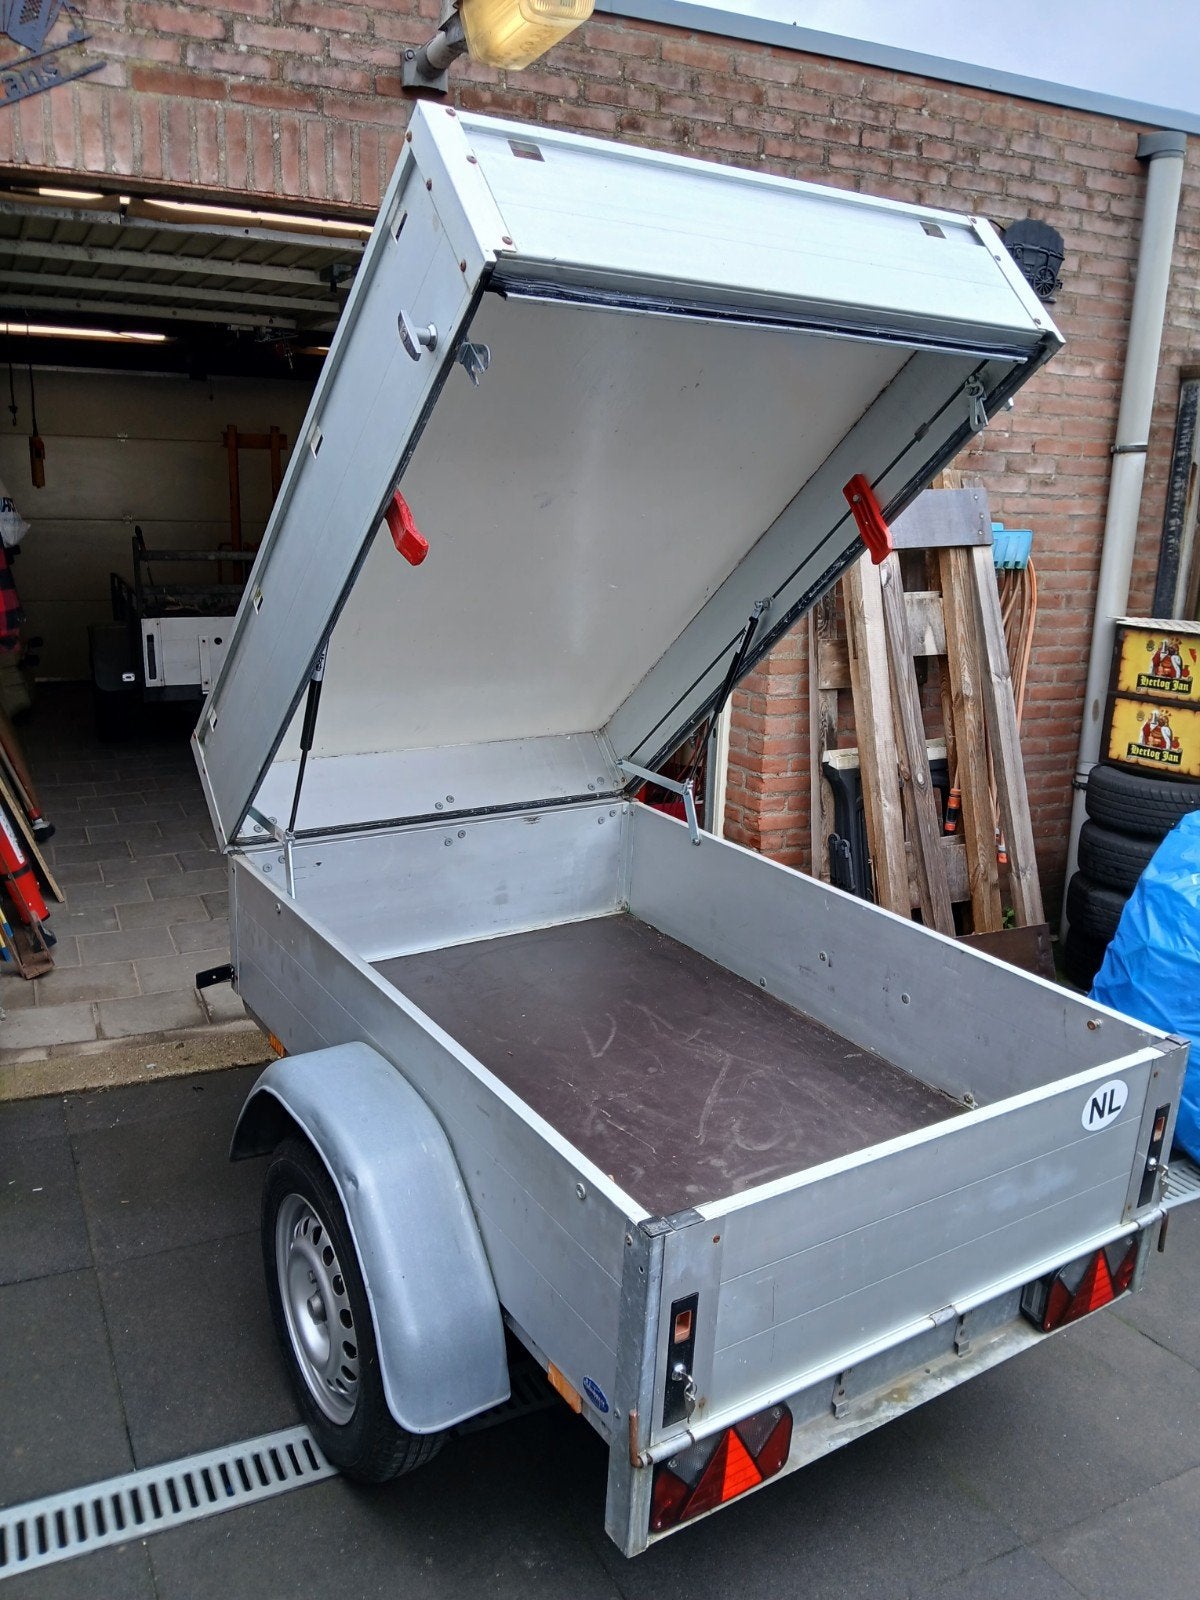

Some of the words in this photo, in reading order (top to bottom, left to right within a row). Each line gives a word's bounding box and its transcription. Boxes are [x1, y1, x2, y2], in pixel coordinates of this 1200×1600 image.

[1141, 675, 1170, 690] Hertog
[1172, 680, 1189, 691] Jan
[1131, 744, 1160, 760] Hertog
[1161, 751, 1179, 762] Jan
[1089, 1088, 1121, 1125] NL
